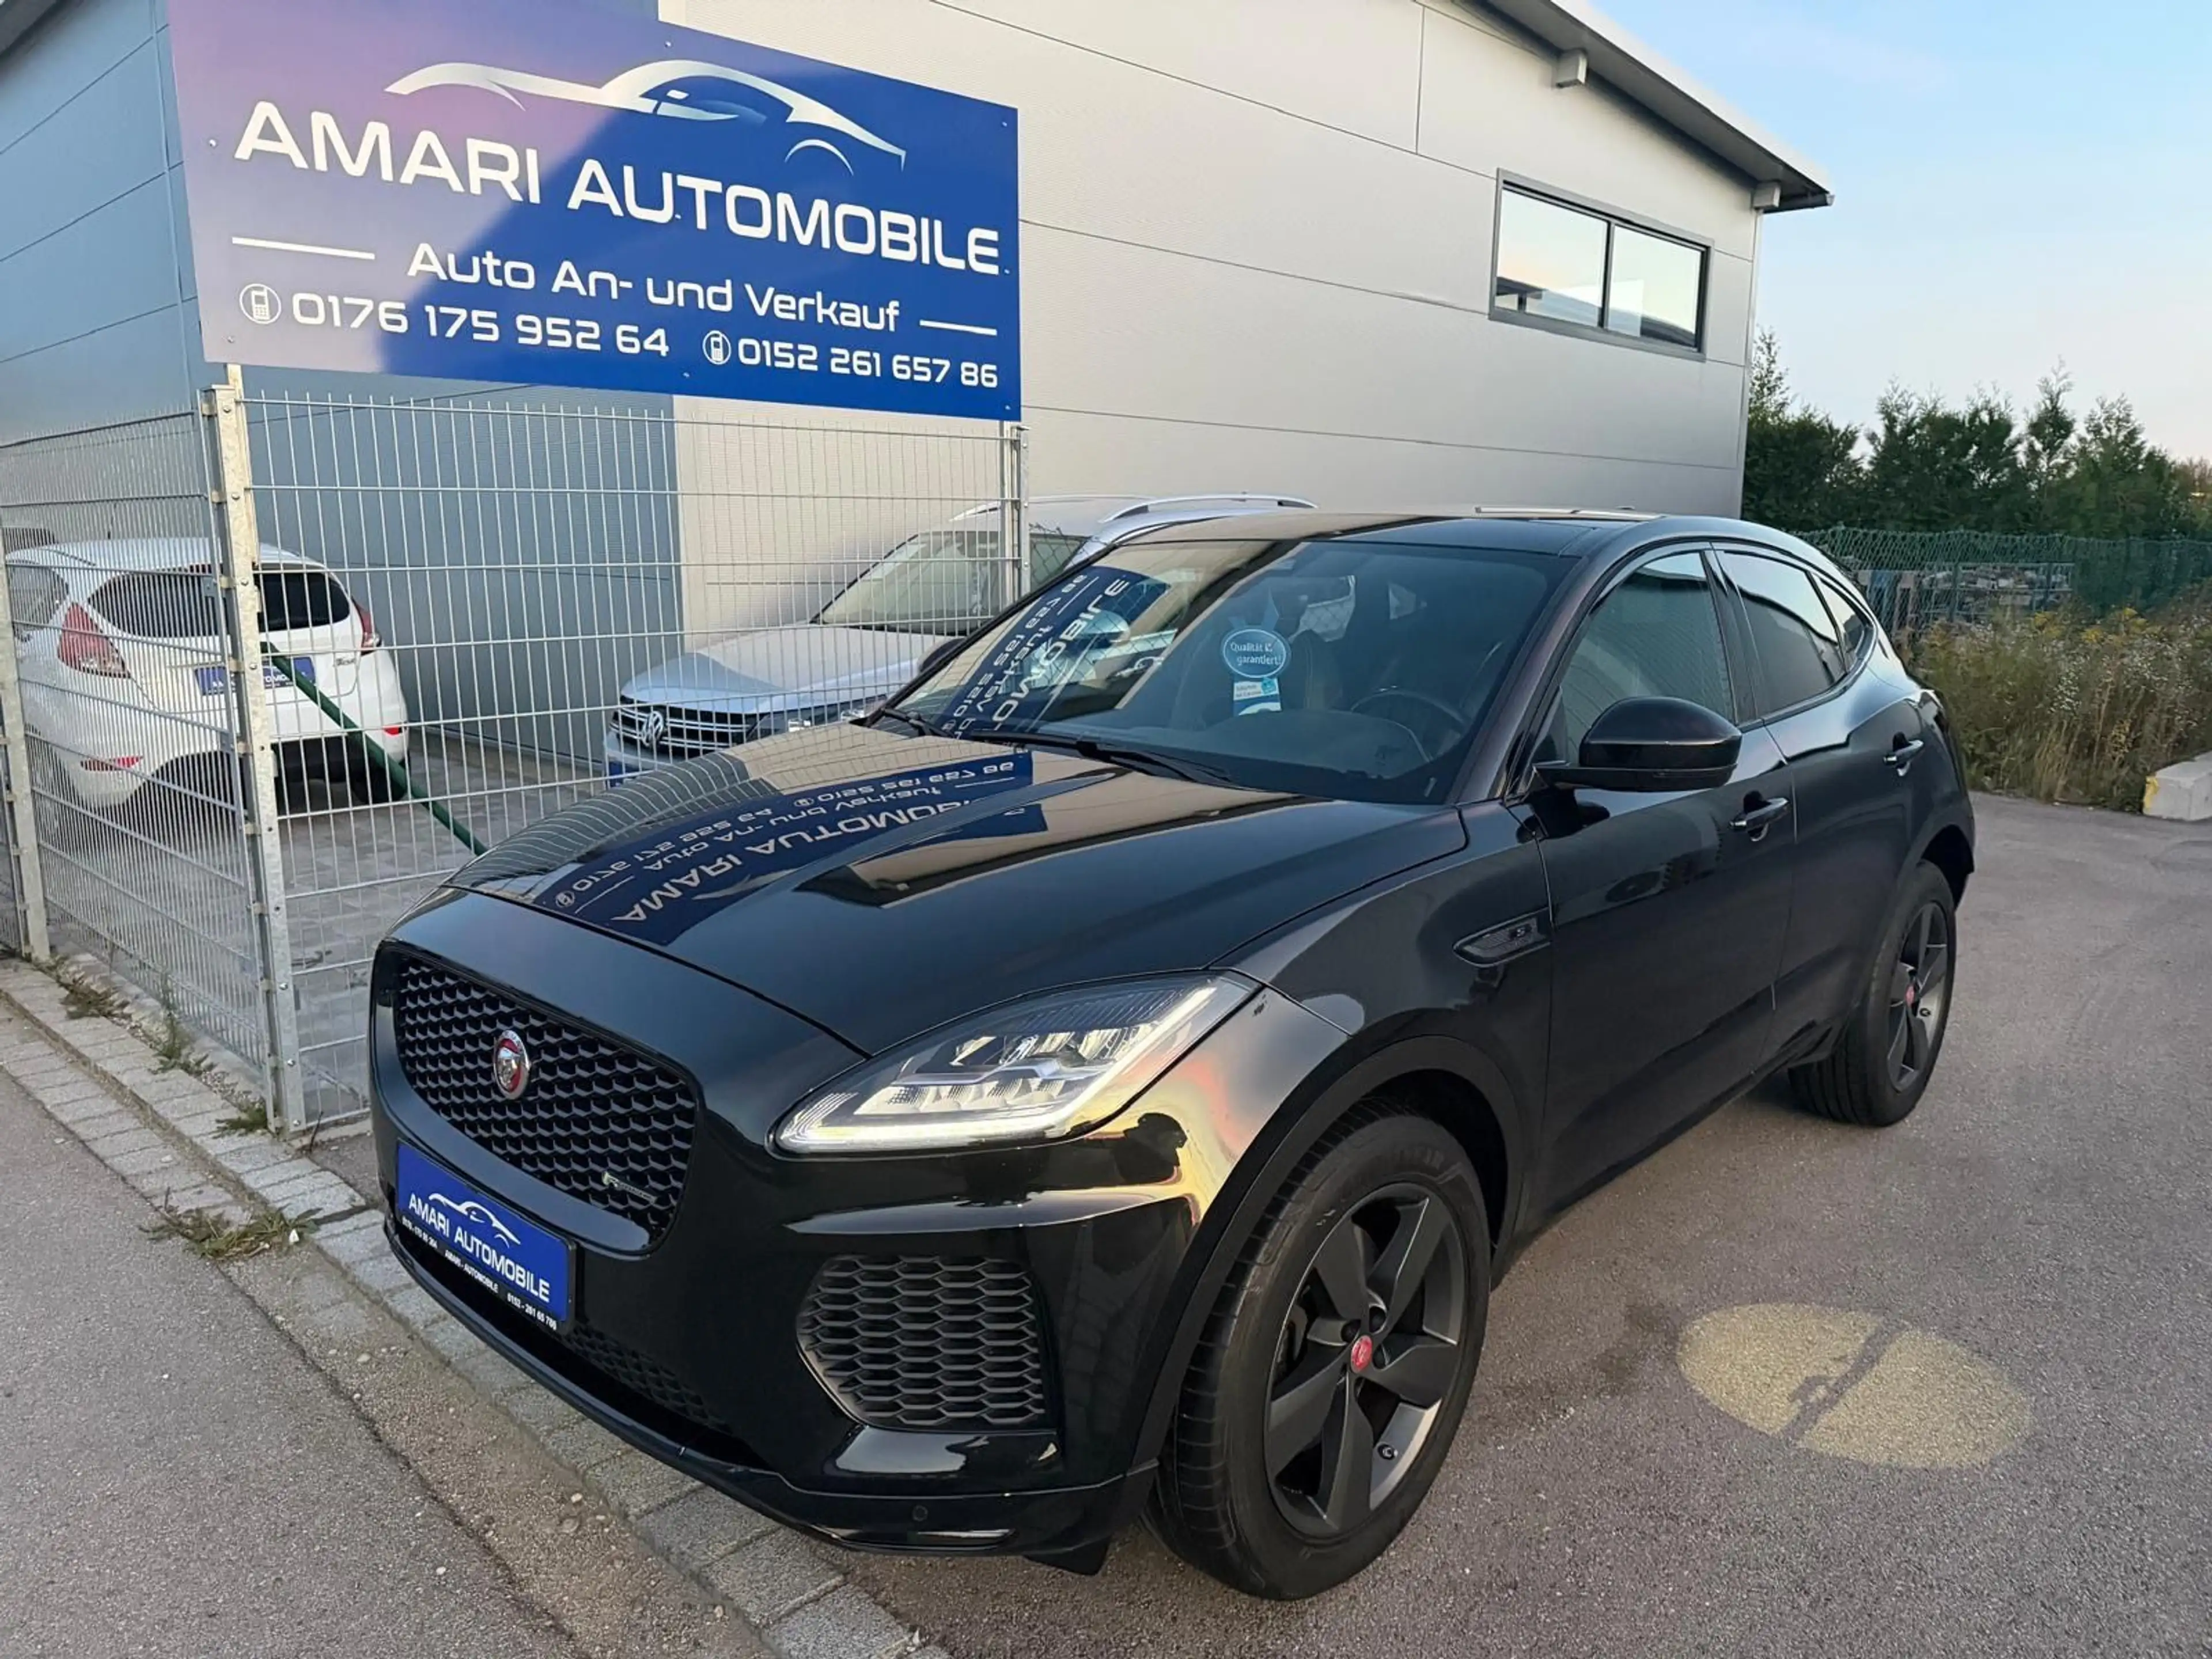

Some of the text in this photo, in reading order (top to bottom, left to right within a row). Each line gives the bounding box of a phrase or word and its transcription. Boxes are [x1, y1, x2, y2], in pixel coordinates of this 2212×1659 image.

[234, 101, 999, 275] AMARI AUTOMOBILE
[293, 292, 669, 357] 0176 175 952 64
[408, 244, 900, 332] Auto An- und Verkauf
[738, 338, 997, 388] 0152 261 657 86
[1230, 642, 1263, 652] Qualität
[409, 1192, 449, 1238] AMARI
[454, 1226, 550, 1302] AUTOMOBILE
